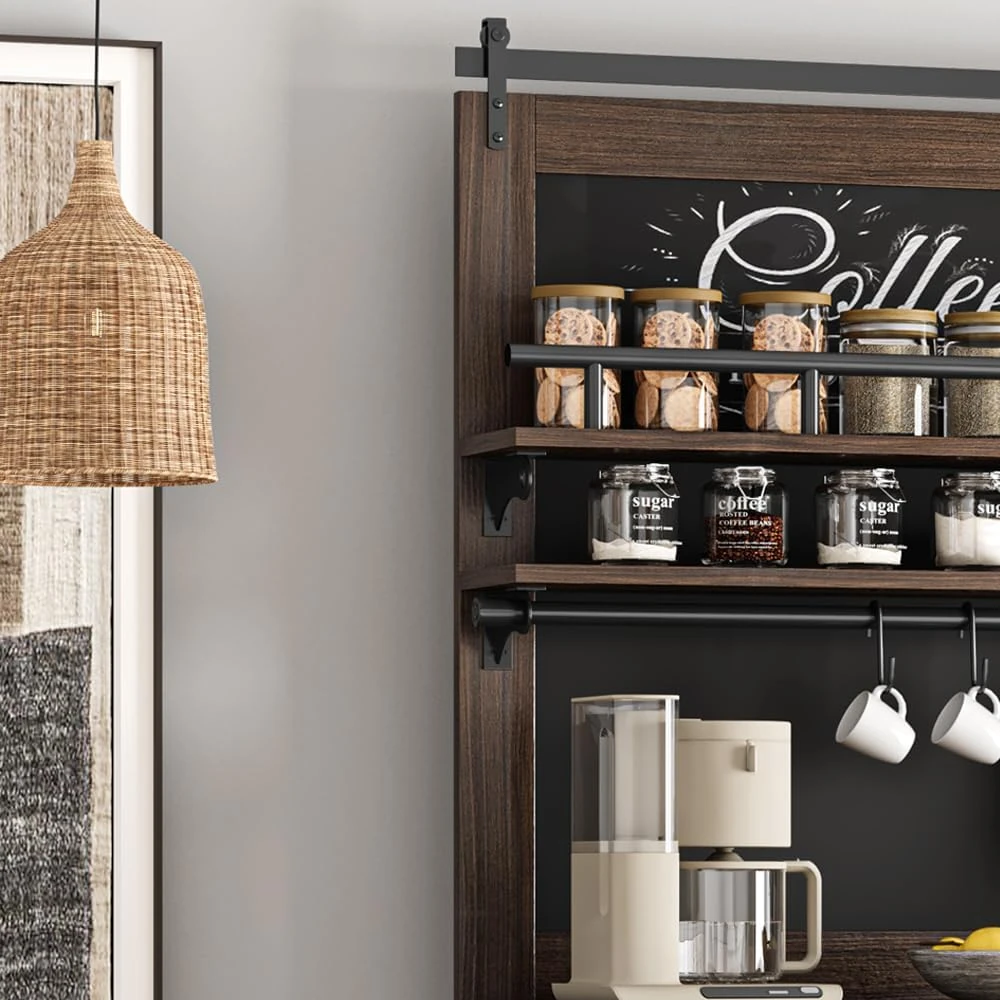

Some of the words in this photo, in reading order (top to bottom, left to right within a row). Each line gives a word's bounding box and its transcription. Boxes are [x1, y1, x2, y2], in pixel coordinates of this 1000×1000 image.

[632, 496, 675, 512] sugar
[718, 495, 768, 511] coffee
[859, 501, 900, 516] sugar
